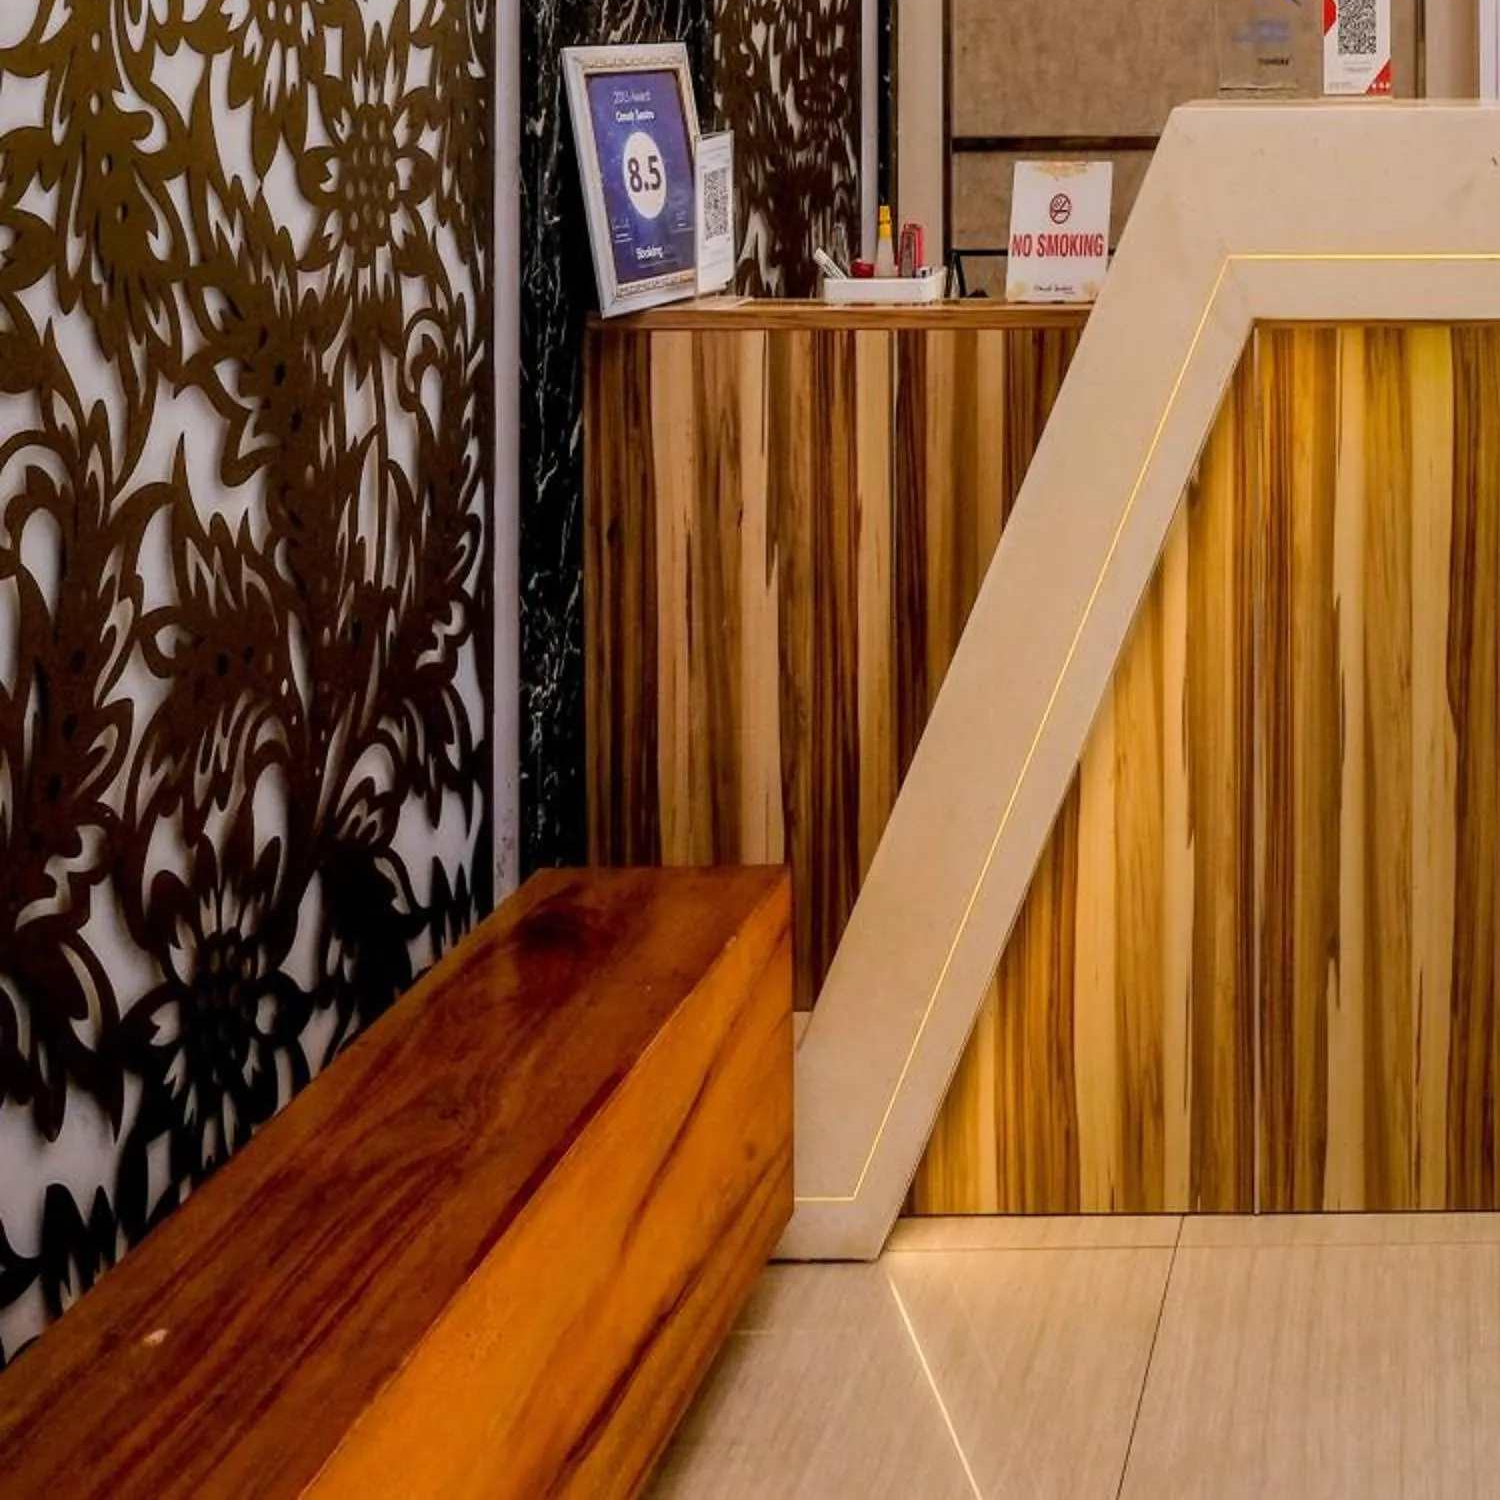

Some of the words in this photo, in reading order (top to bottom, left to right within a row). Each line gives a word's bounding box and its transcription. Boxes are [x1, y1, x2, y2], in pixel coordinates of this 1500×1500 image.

[628, 156, 661, 193] 8.5
[1011, 233, 1033, 258] NO
[1037, 233, 1104, 258] SMOKING
